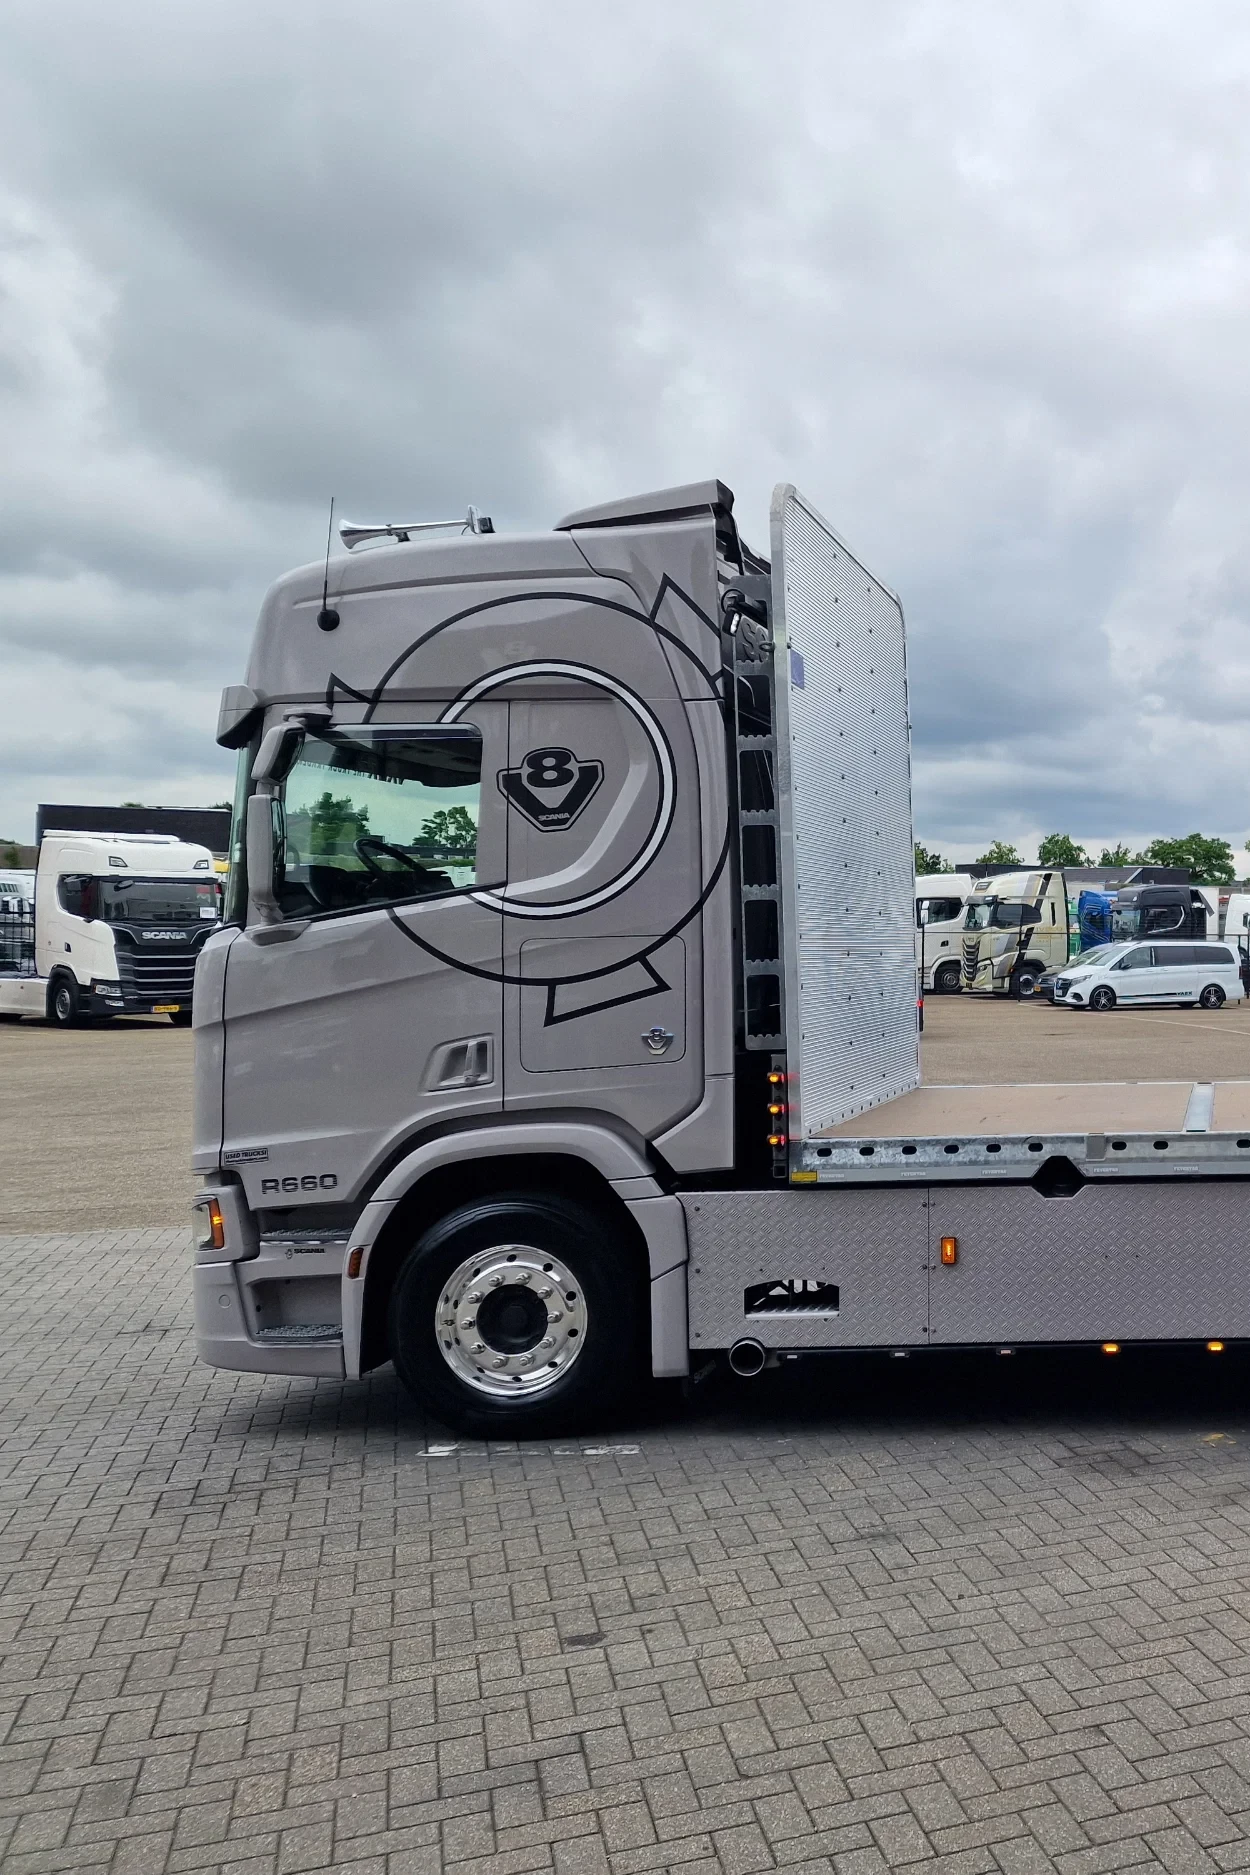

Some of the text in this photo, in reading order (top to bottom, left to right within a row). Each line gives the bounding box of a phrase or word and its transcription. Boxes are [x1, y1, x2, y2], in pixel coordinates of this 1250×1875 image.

[537, 812, 571, 821] SCANIA
[141, 931, 188, 940] SCANIA
[225, 1152, 241, 1160] USED
[261, 1173, 338, 1195] R660
